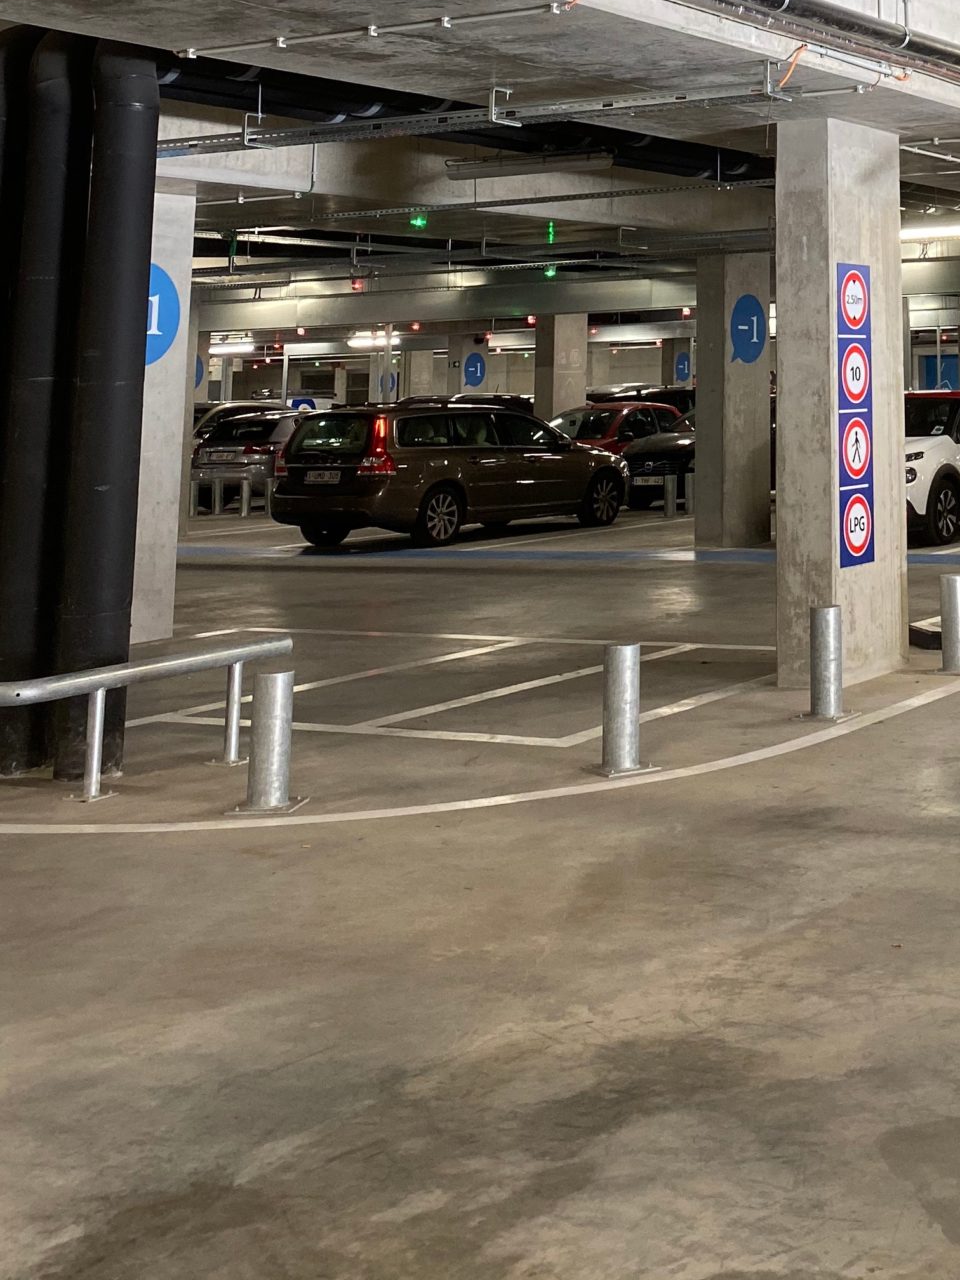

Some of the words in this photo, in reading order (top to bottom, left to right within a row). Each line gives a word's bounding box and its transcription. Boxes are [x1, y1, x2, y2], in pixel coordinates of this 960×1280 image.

[737, 315, 760, 343] -1
[468, 362, 481, 377] -1
[850, 366, 861, 382] 10
[849, 515, 865, 533] LPG
